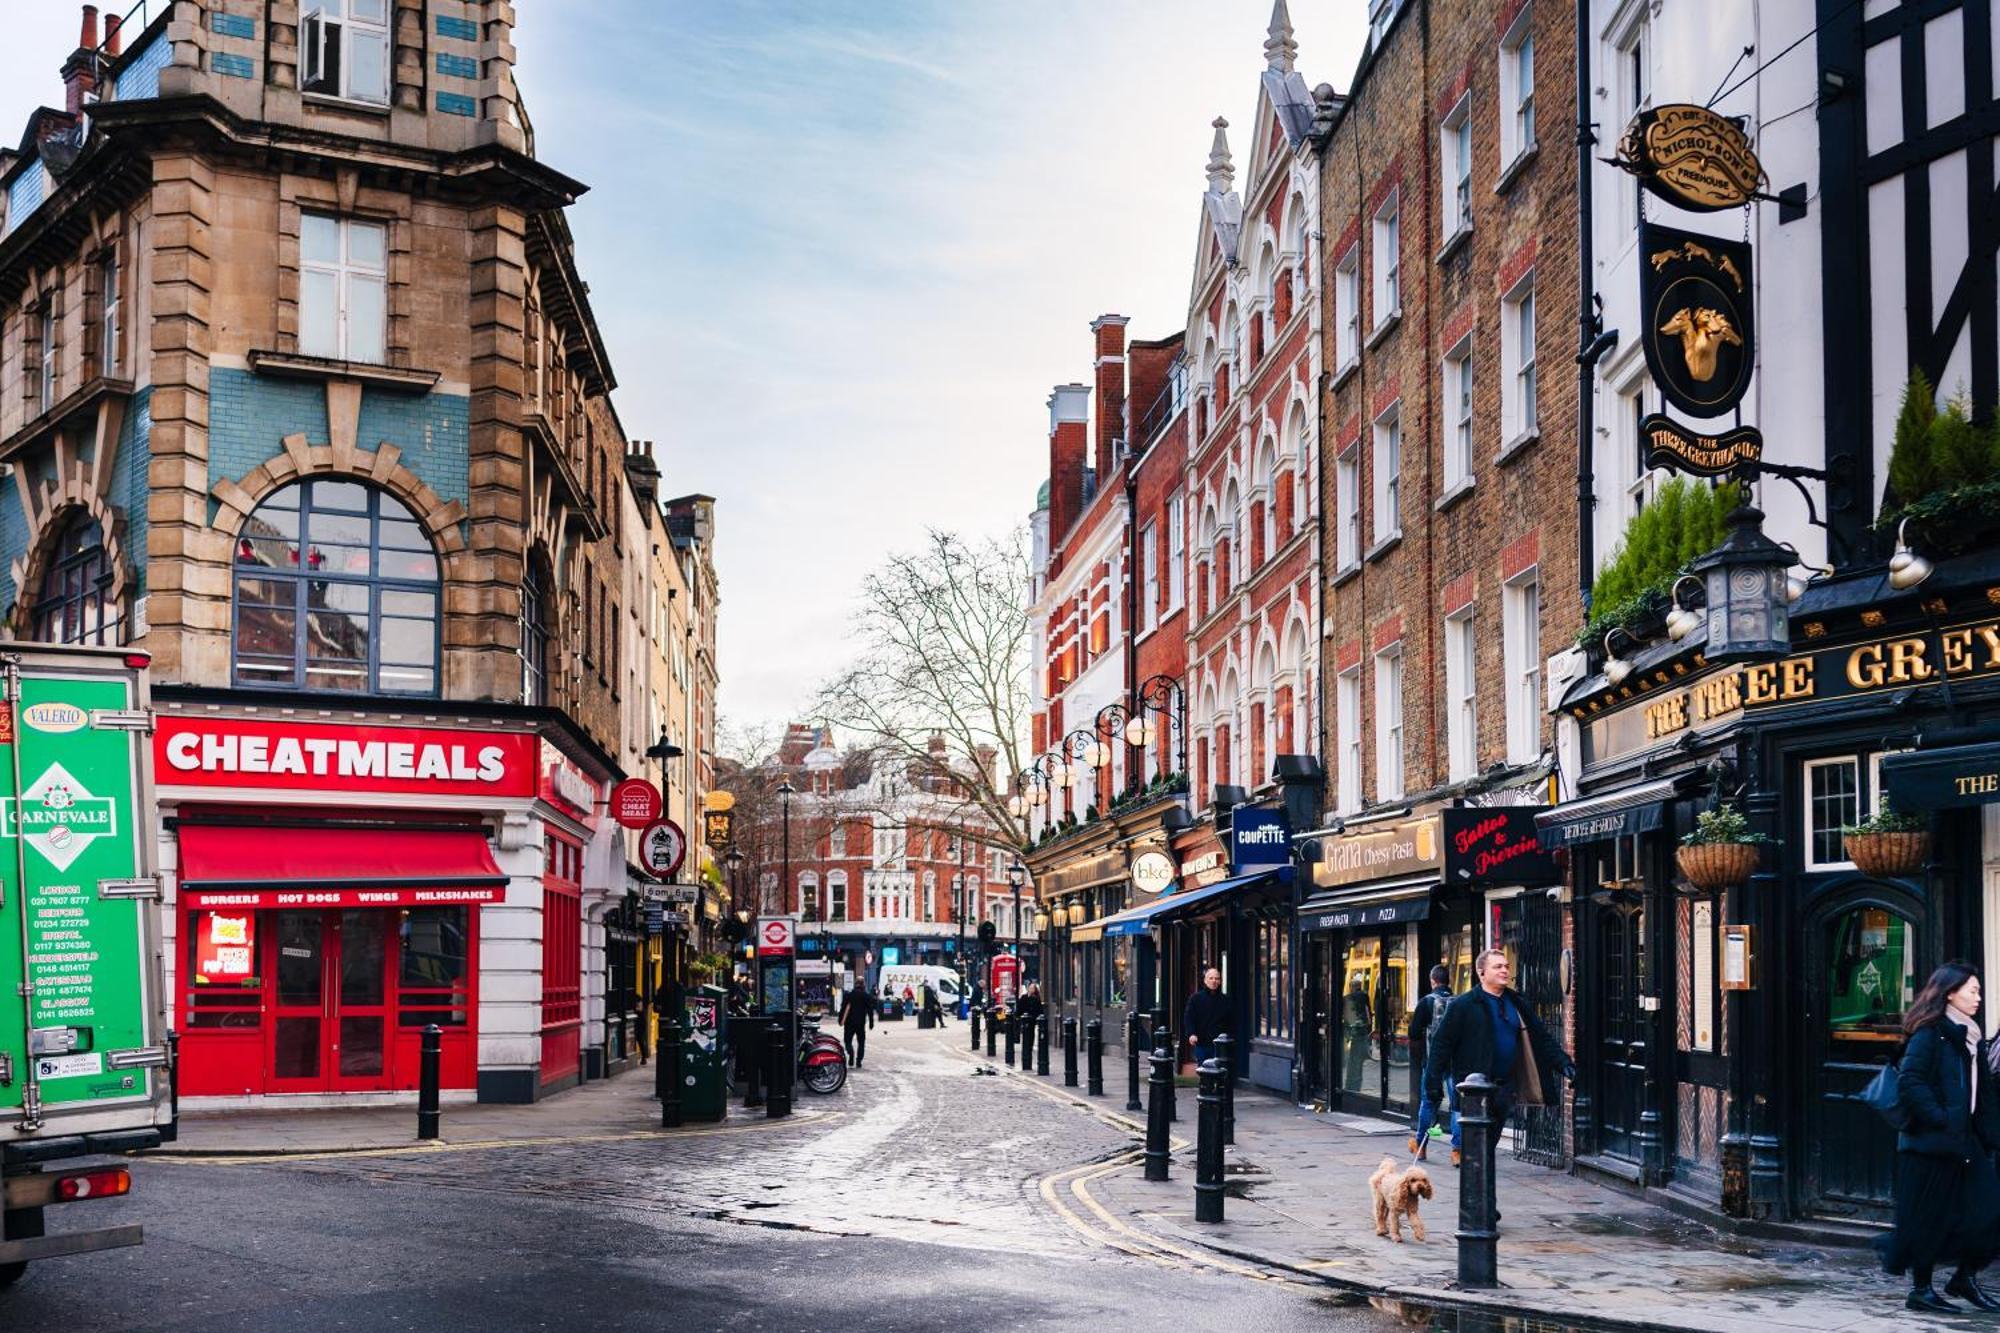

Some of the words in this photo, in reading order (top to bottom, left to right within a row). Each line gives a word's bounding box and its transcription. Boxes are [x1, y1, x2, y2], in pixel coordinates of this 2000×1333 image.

[1662, 137, 1751, 180] NICHOLSON'S
[1678, 168, 1730, 190] FREEHOUSE
[1696, 437, 1719, 449] THE
[1644, 696, 1690, 740] THE
[1692, 656, 1815, 722] THREE
[31, 708, 80, 724] VALERIO
[165, 731, 506, 783] CHEATMEALS
[1954, 774, 1999, 796] THE
[1238, 830, 1285, 844] COUPETTE
[1455, 813, 1508, 853] Tattoo
[1325, 841, 1361, 874] Grana
[1391, 841, 1414, 861] Pasta
[1475, 835, 1544, 876] Piercin
[31, 897, 47, 906] 020
[200, 894, 260, 905] BURGERS
[277, 893, 304, 903] HOT
[306, 892, 340, 903] DOGS
[358, 891, 399, 901] WINGS
[415, 890, 493, 901] MILKSHAKES
[34, 943, 53, 951] 0117
